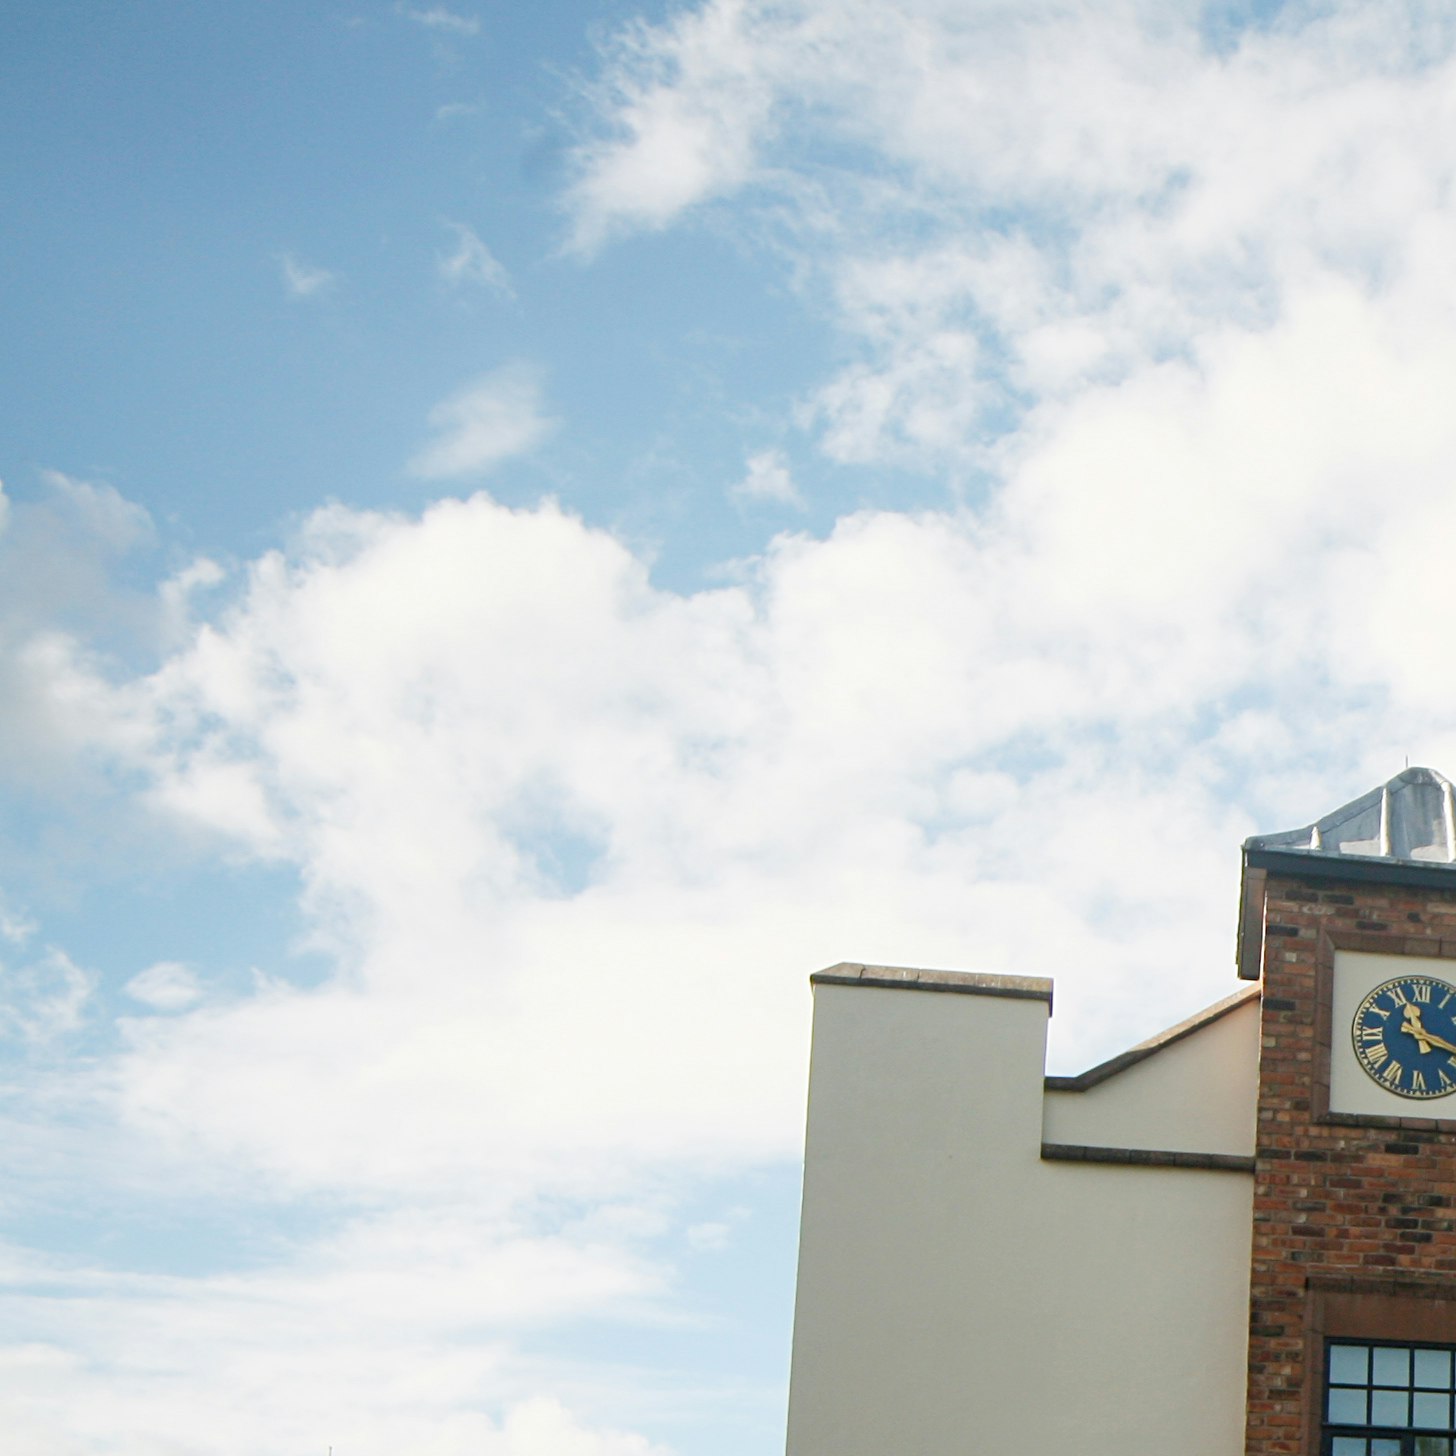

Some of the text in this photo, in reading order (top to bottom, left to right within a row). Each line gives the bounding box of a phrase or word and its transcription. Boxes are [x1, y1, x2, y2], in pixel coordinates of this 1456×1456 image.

[1386, 986, 1407, 1008] XI
[1412, 984, 1431, 1003] XII
[1438, 993, 1452, 1009] I
[1369, 1003, 1391, 1020] X
[1362, 1026, 1383, 1040] IX
[1365, 1042, 1389, 1069] VIII
[1383, 1060, 1403, 1085] VII
[1412, 1070, 1427, 1090] VI
[1438, 1068, 1452, 1087] V
